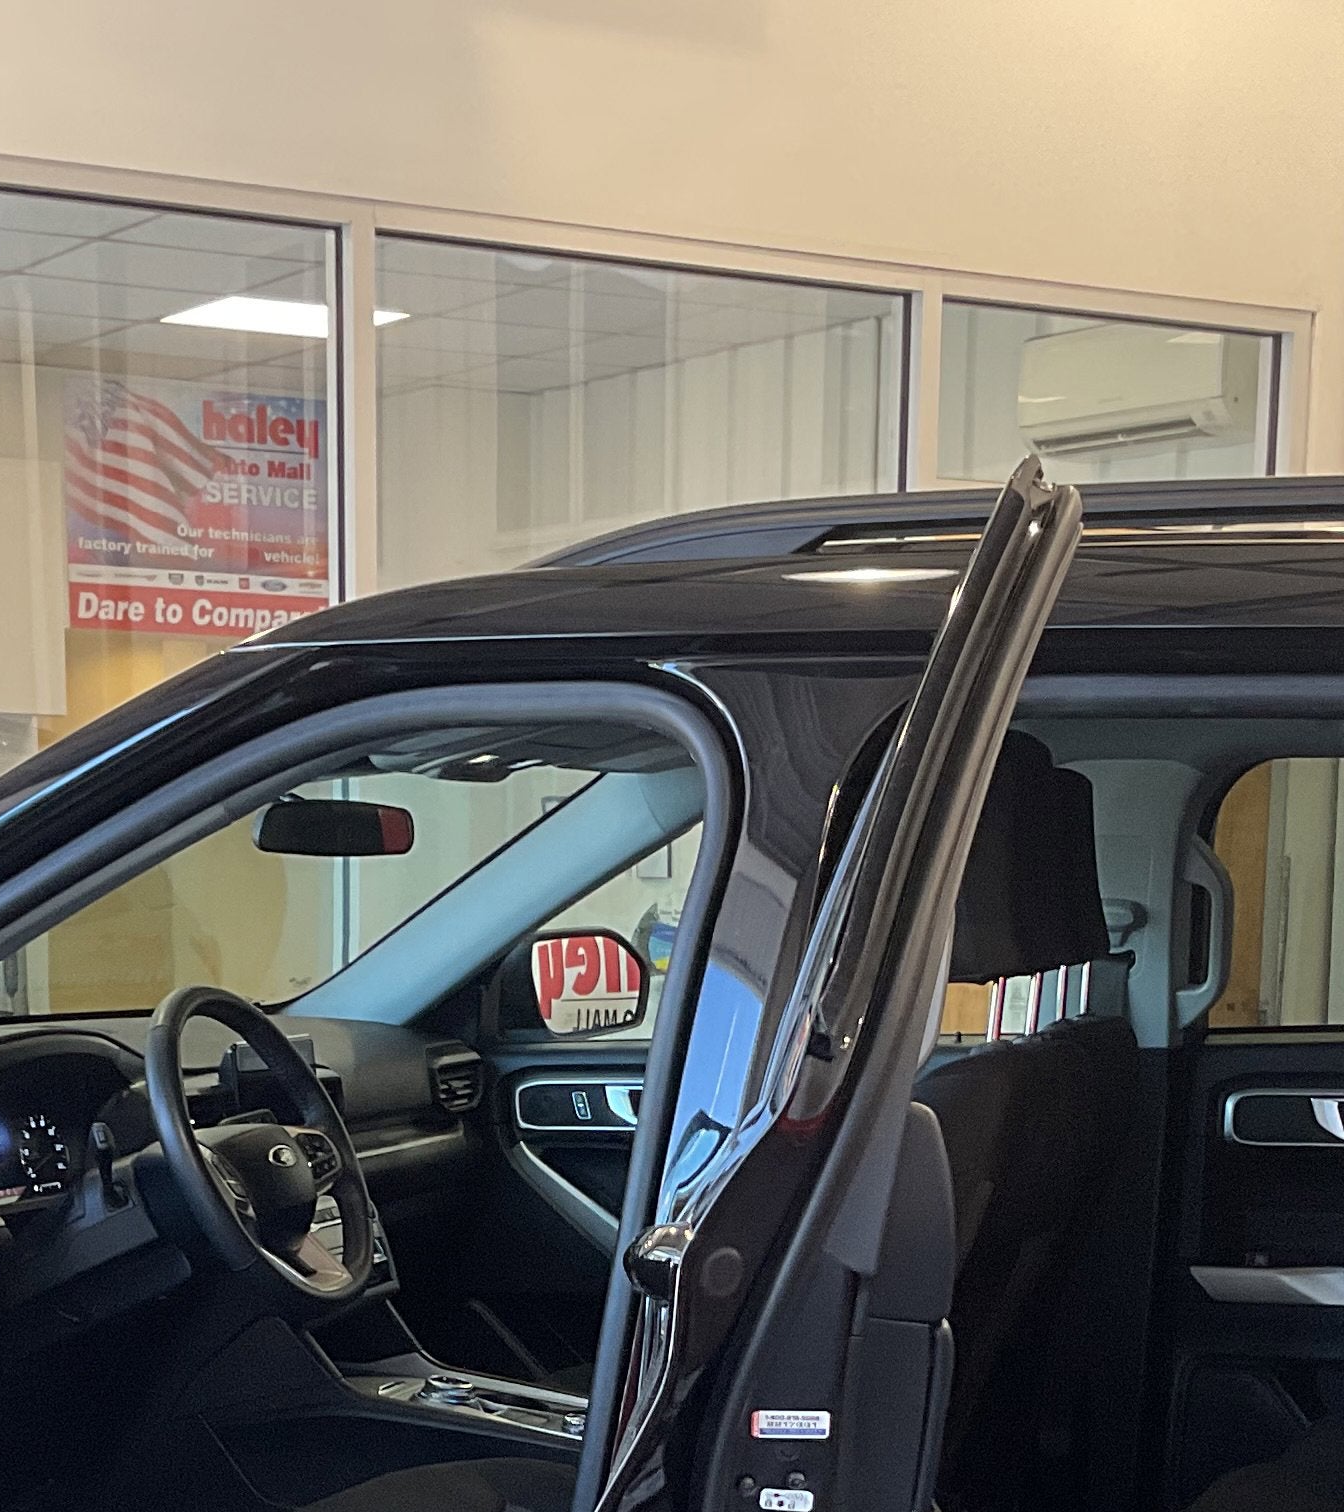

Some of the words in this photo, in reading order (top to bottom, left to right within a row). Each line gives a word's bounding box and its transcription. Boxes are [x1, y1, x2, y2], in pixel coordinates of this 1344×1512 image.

[202, 399, 319, 459] haley
[267, 460, 312, 481] Mall
[205, 481, 318, 510] SERVICE
[177, 524, 204, 539] Our
[208, 526, 292, 545] technicians
[78, 537, 132, 555] factory
[136, 541, 188, 557] trained
[192, 544, 215, 561] for
[77, 591, 145, 622] Dare
[155, 596, 184, 624] to
[191, 598, 326, 634] Compar
